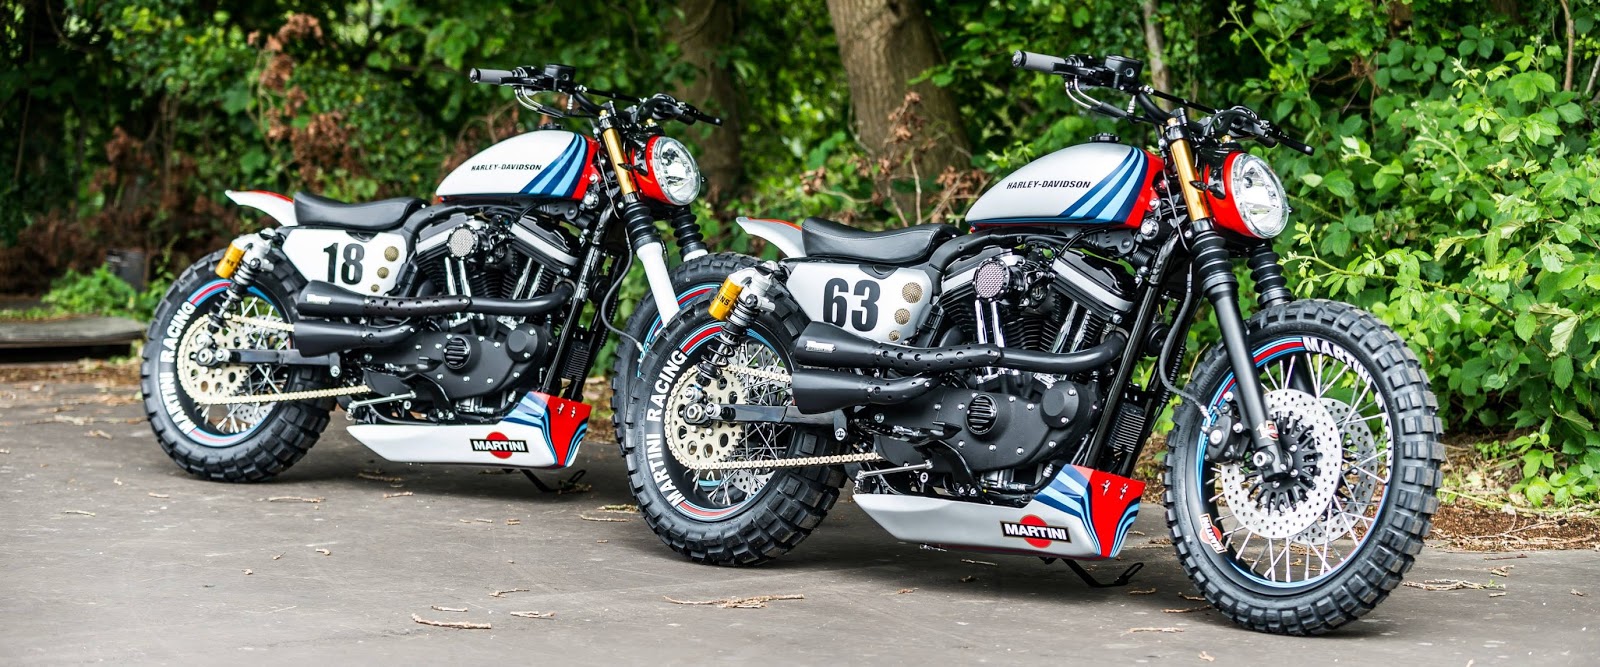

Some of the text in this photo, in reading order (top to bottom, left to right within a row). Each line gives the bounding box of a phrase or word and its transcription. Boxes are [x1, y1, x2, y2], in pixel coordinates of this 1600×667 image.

[471, 163, 542, 172] HARLEY-DAVIDSON
[1006, 180, 1092, 190] HARLEY-DAVIDSON
[323, 242, 365, 285] 18
[822, 277, 881, 332] 63
[159, 300, 197, 434] MARTINI RACING
[1302, 336, 1373, 386] MARTINI
[473, 440, 526, 451] MARTINI
[646, 350, 688, 507] MARTINI RACING
[1004, 523, 1067, 540] MARTINI
